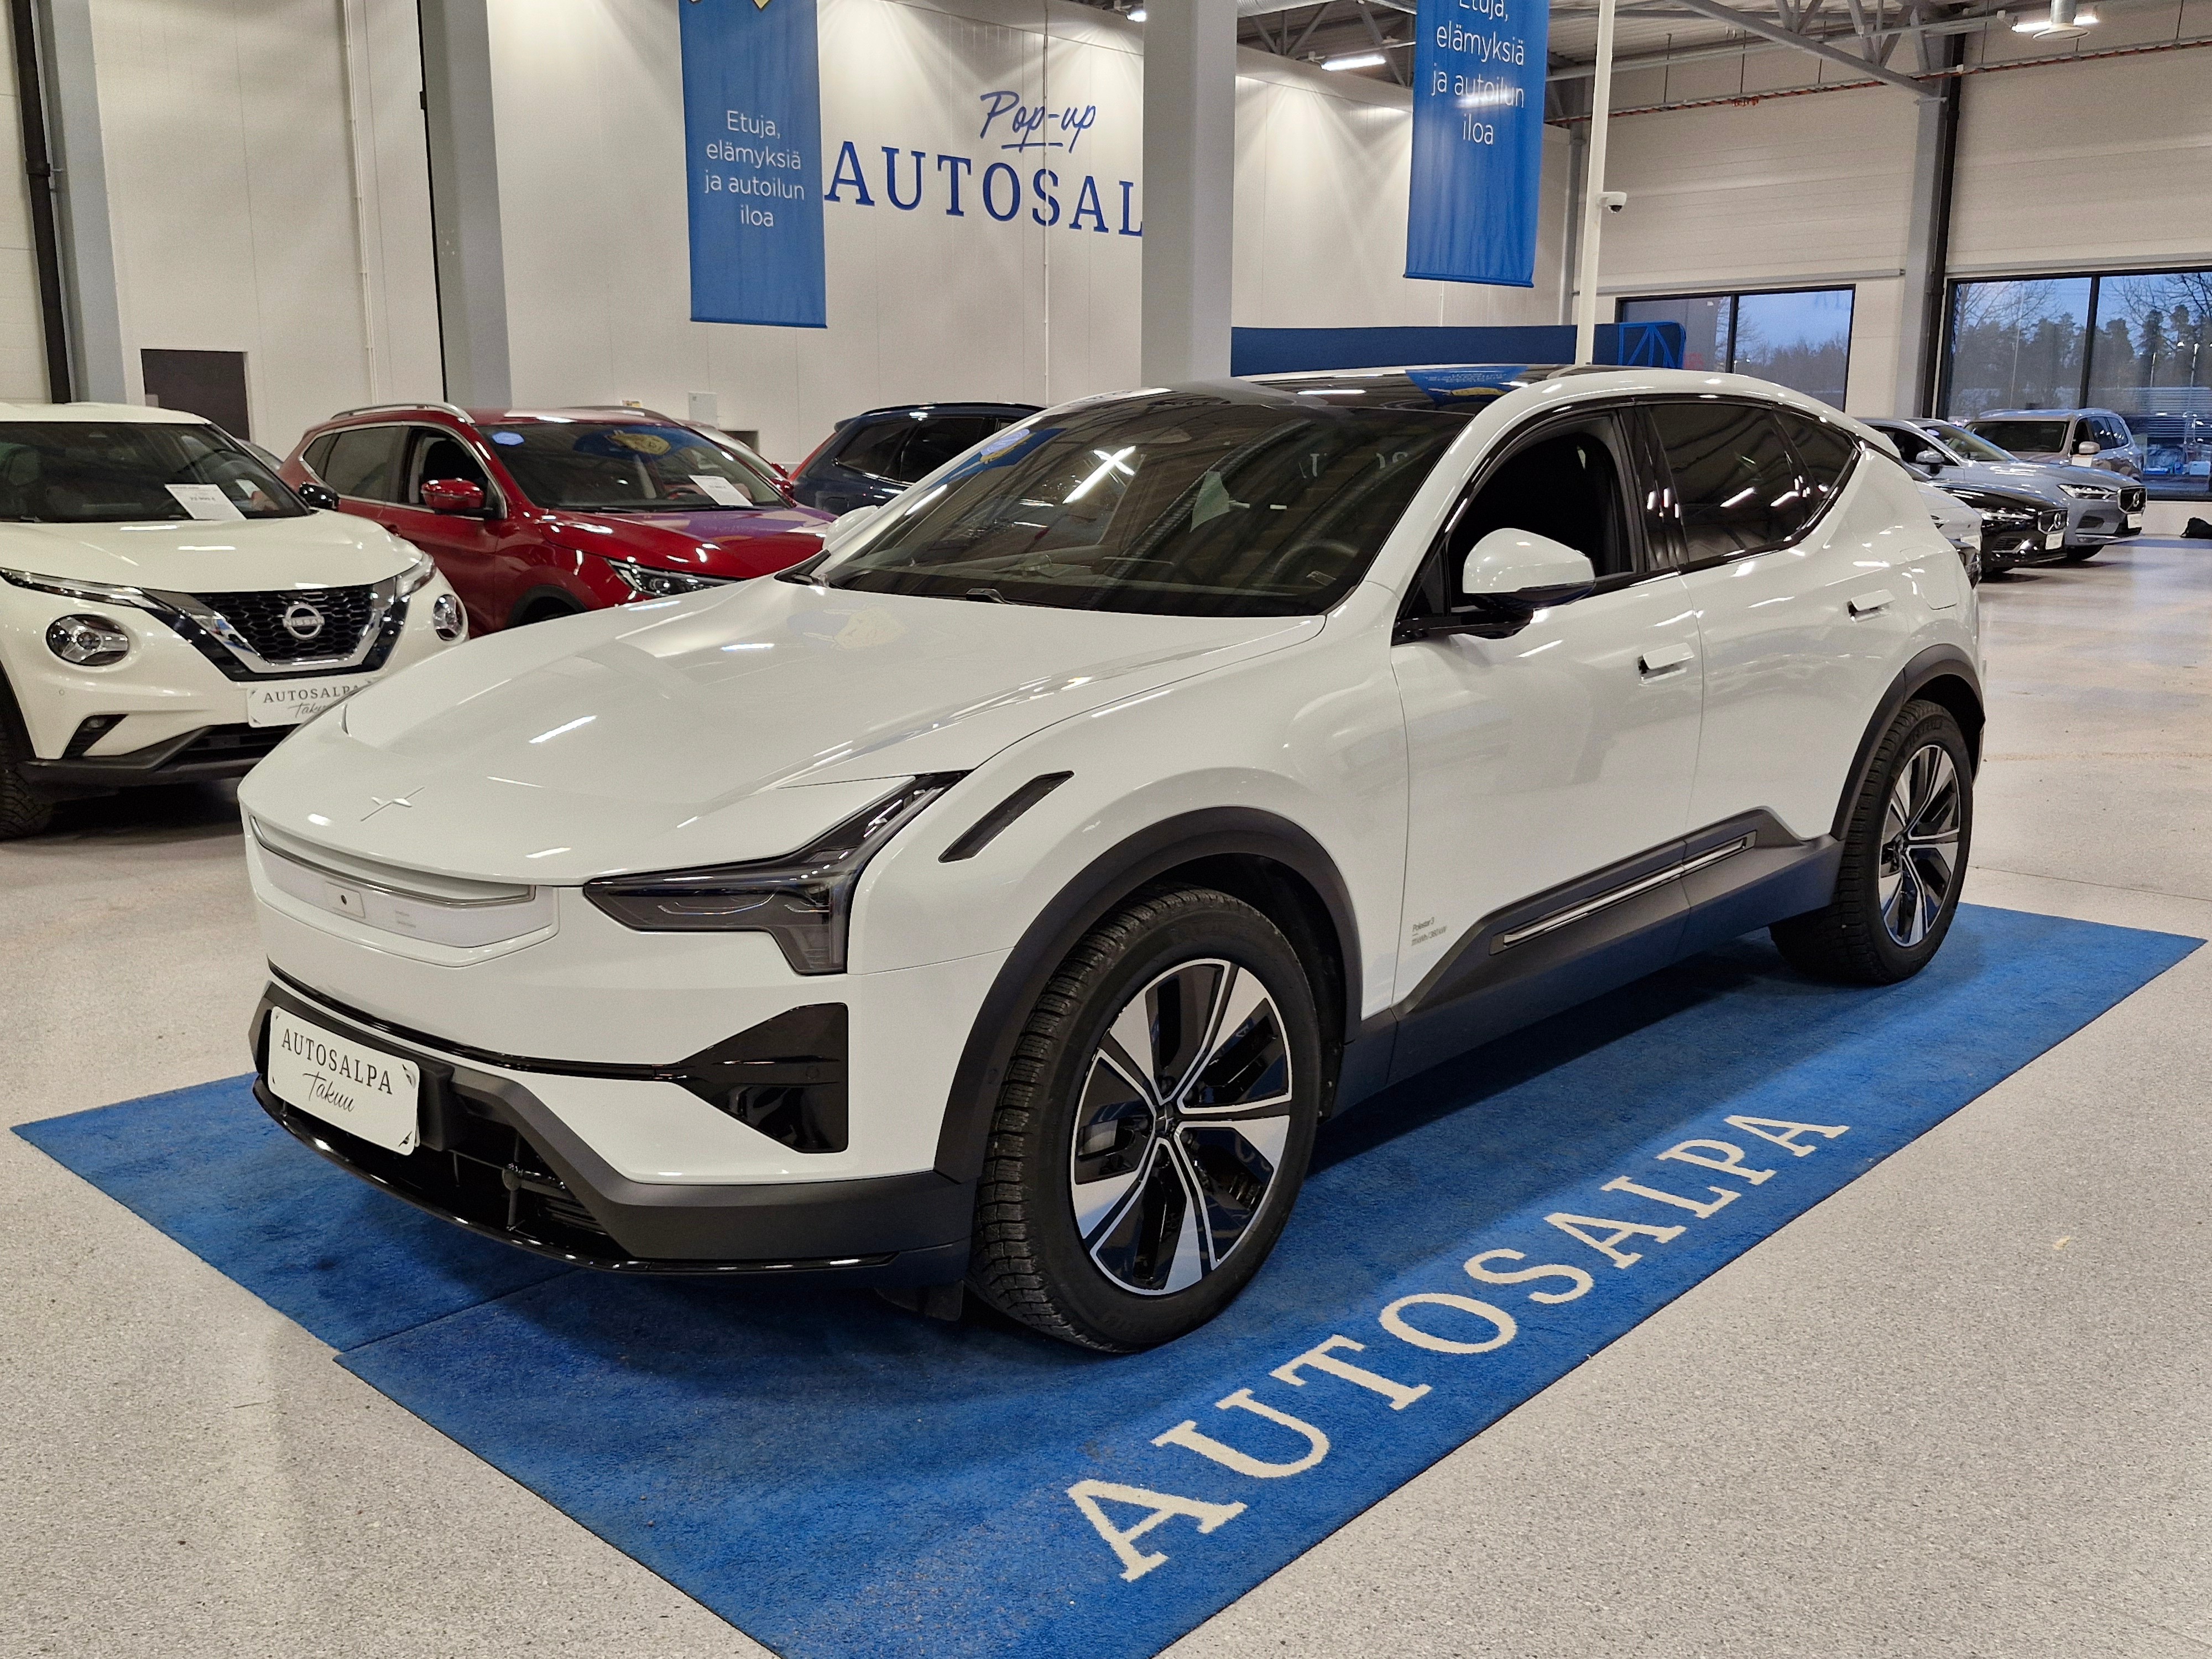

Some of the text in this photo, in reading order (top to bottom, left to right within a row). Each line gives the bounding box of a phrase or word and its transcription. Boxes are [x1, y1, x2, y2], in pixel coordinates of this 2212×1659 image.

[1459, 0, 1508, 22] uja,
[1436, 20, 1525, 66] elämyksiä
[1431, 62, 1524, 108] ja autoilun
[727, 110, 780, 139] Etuja,
[980, 90, 1097, 153] Pop-up
[1463, 113, 1494, 145] iloa
[706, 139, 801, 170] elämyksiä
[705, 169, 805, 200] ja autoilun
[824, 140, 1142, 237] AUTOSAL
[740, 204, 774, 227] iloa
[283, 617, 324, 628] NISSAN
[281, 1028, 392, 1095] AUTOSALPA
[302, 1071, 355, 1112] Takuu
[1065, 1115, 1849, 1582] AUTOSALPA
